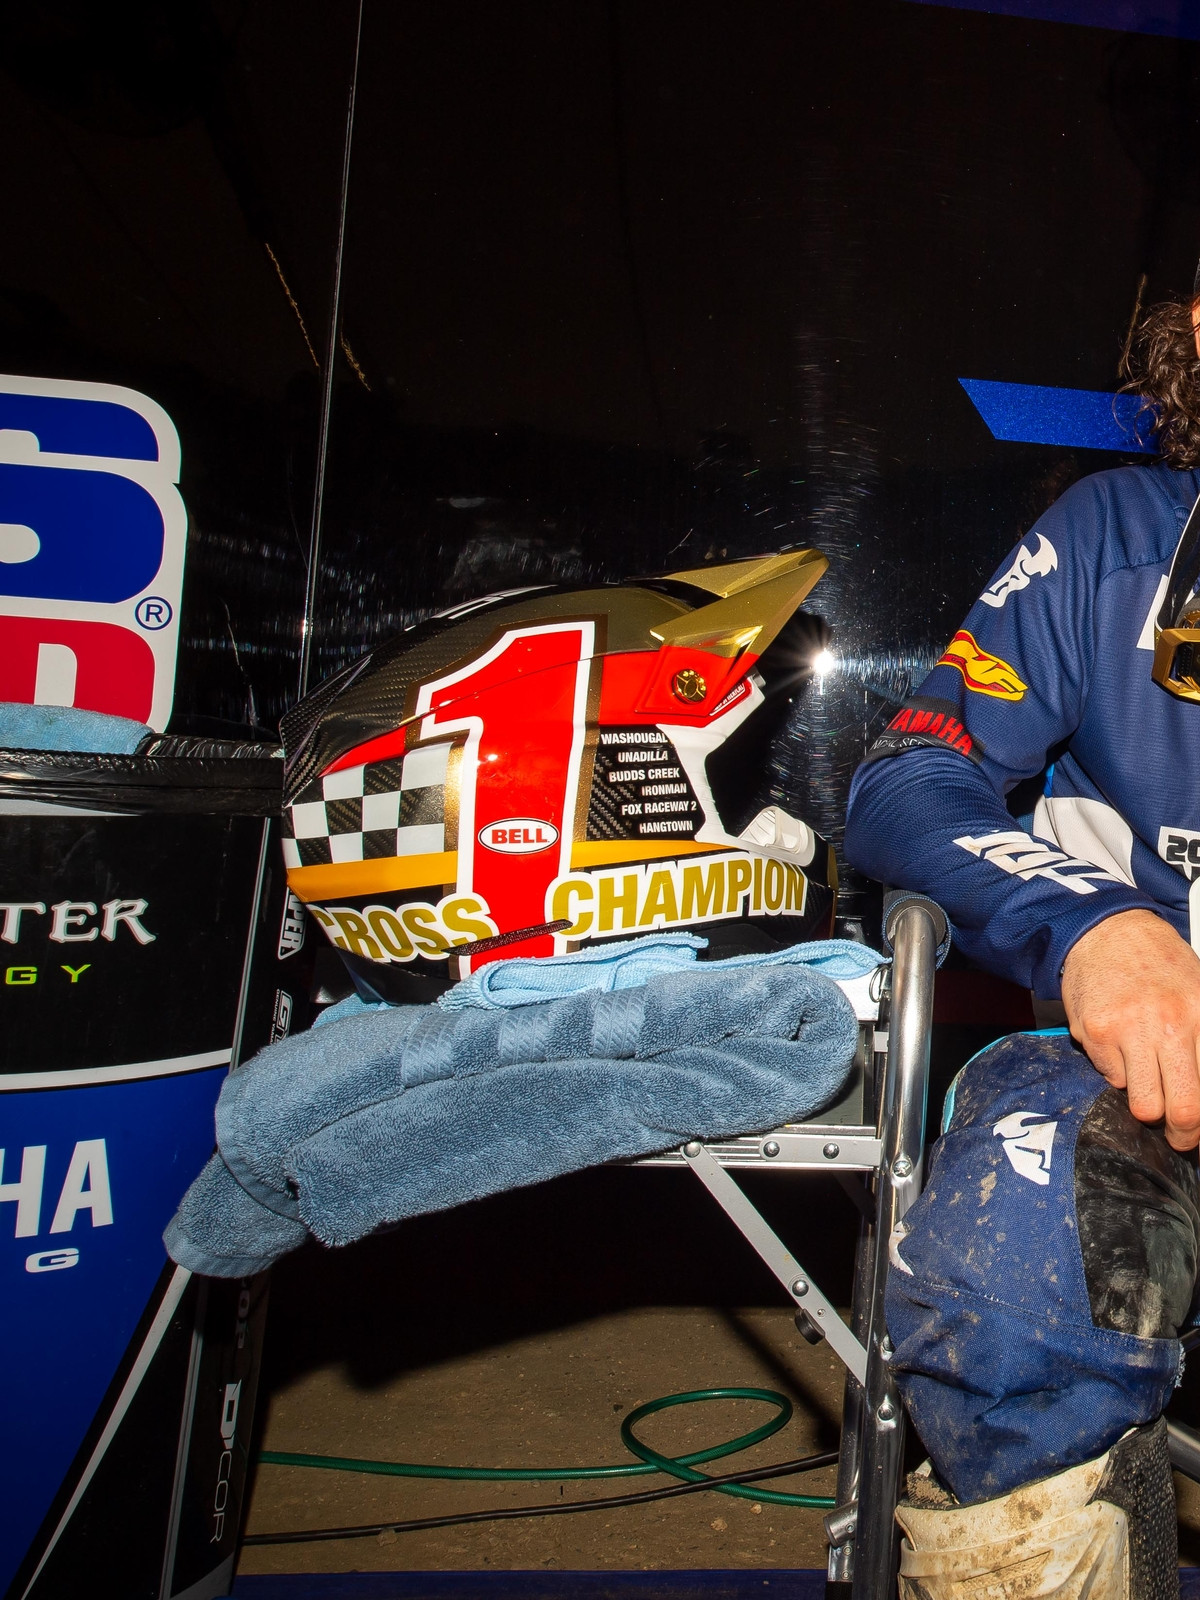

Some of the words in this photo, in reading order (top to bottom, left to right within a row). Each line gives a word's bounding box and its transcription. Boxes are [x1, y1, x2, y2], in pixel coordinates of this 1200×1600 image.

[886, 708, 973, 757] AMAHA
[617, 748, 668, 763] UNADILLA
[609, 769, 645, 782] BUDDS
[647, 767, 680, 780] CREEK
[641, 783, 687, 796] IRONMAN
[621, 803, 642, 816] FOX
[644, 801, 689, 814] RACEWAY
[690, 801, 698, 812] 2
[490, 827, 551, 845] BELL
[639, 820, 694, 834] HANGTOWN
[552, 858, 806, 936] CHAMPION
[0, 898, 157, 945] TER
[5, 964, 92, 985] GY
[0, 1138, 114, 1239] HA
